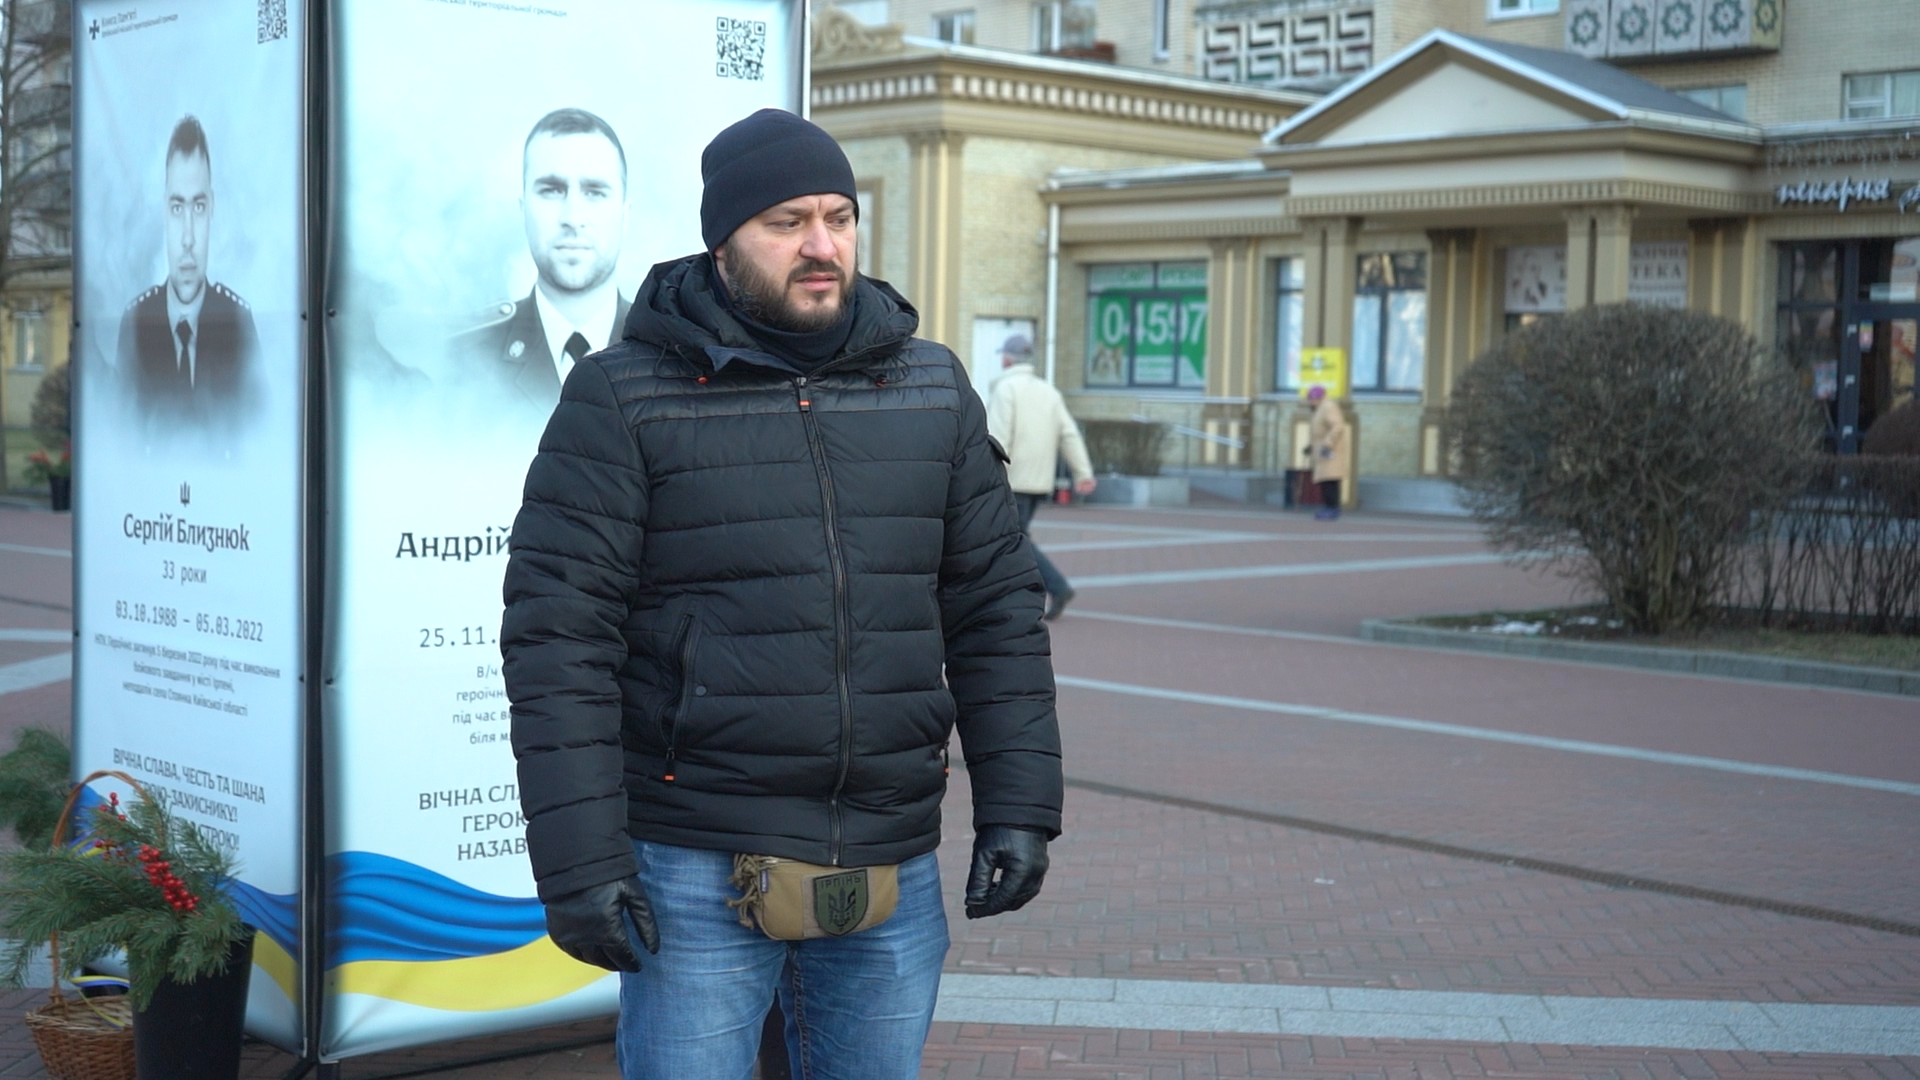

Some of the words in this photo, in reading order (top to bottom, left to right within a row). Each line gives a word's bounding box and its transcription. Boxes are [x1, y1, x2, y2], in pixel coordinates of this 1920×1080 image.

[1776, 175, 1891, 213] пекарня
[123, 512, 173, 545] Сергій
[177, 517, 250, 553] Близнюк
[395, 526, 512, 562] Андрій
[162, 559, 175, 580] 33
[181, 565, 207, 586] роки
[115, 599, 177, 628] 03.10.1988
[196, 612, 263, 642] 05.03.2022
[419, 626, 497, 648] 25.11.
[453, 710, 472, 725] під
[475, 711, 496, 722] час
[469, 731, 496, 745] біля
[113, 748, 143, 771] ВІЧНА
[144, 755, 181, 783] СЛАВА,
[182, 765, 216, 790] ЧЕСТЬ
[216, 774, 230, 795] ТА
[232, 779, 266, 804] ШАНА
[419, 787, 483, 811] ВІЧНА
[457, 837, 527, 861] НАЗАВ
[821, 875, 861, 889] ІРПІНЬ
